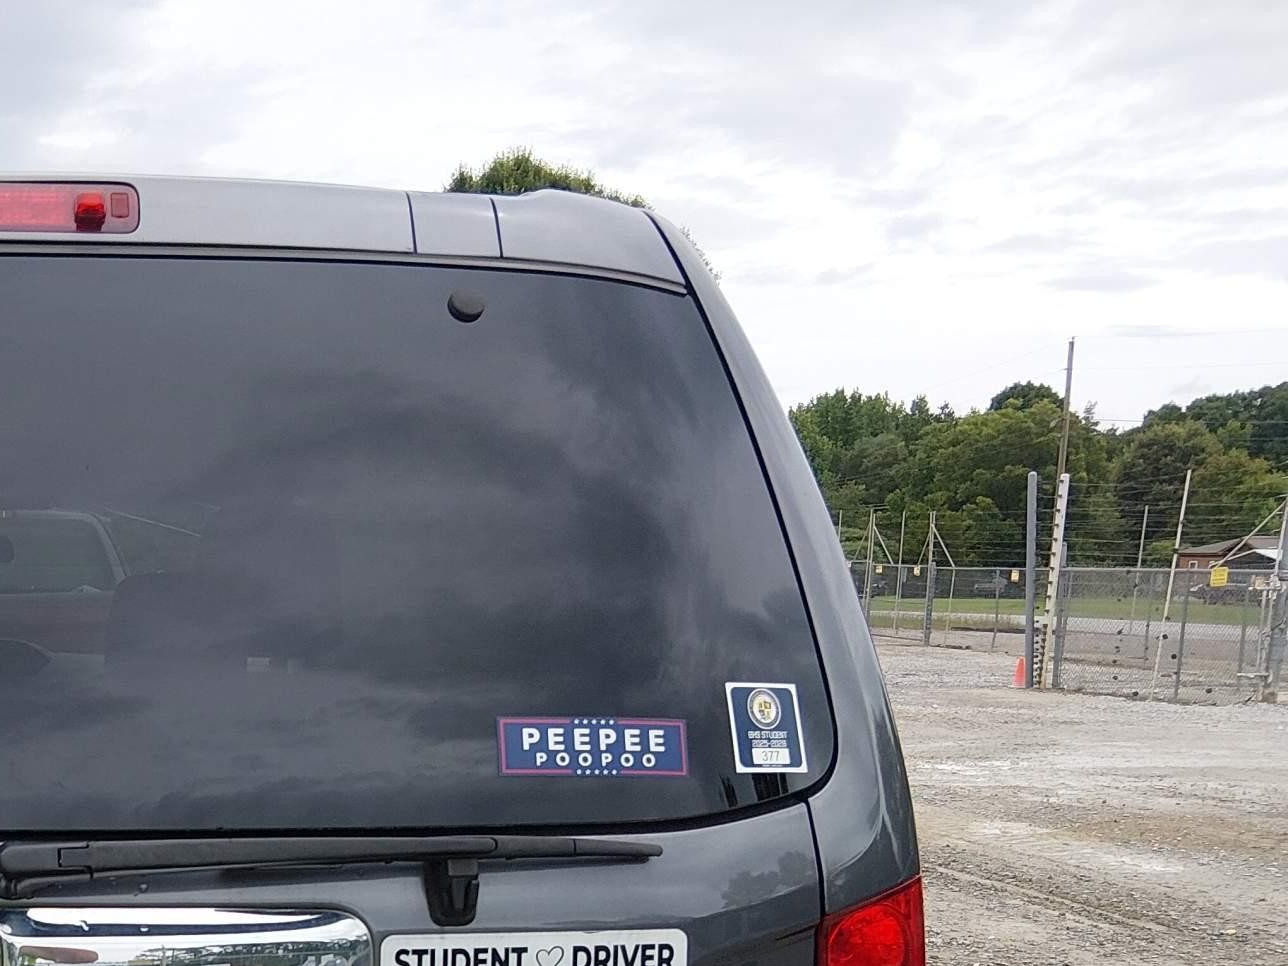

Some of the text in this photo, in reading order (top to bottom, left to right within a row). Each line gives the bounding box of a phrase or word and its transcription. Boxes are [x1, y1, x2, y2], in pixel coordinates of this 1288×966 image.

[521, 727, 666, 752] PEEPEE
[535, 752, 657, 768] POOPOO
[761, 750, 780, 762] 377
